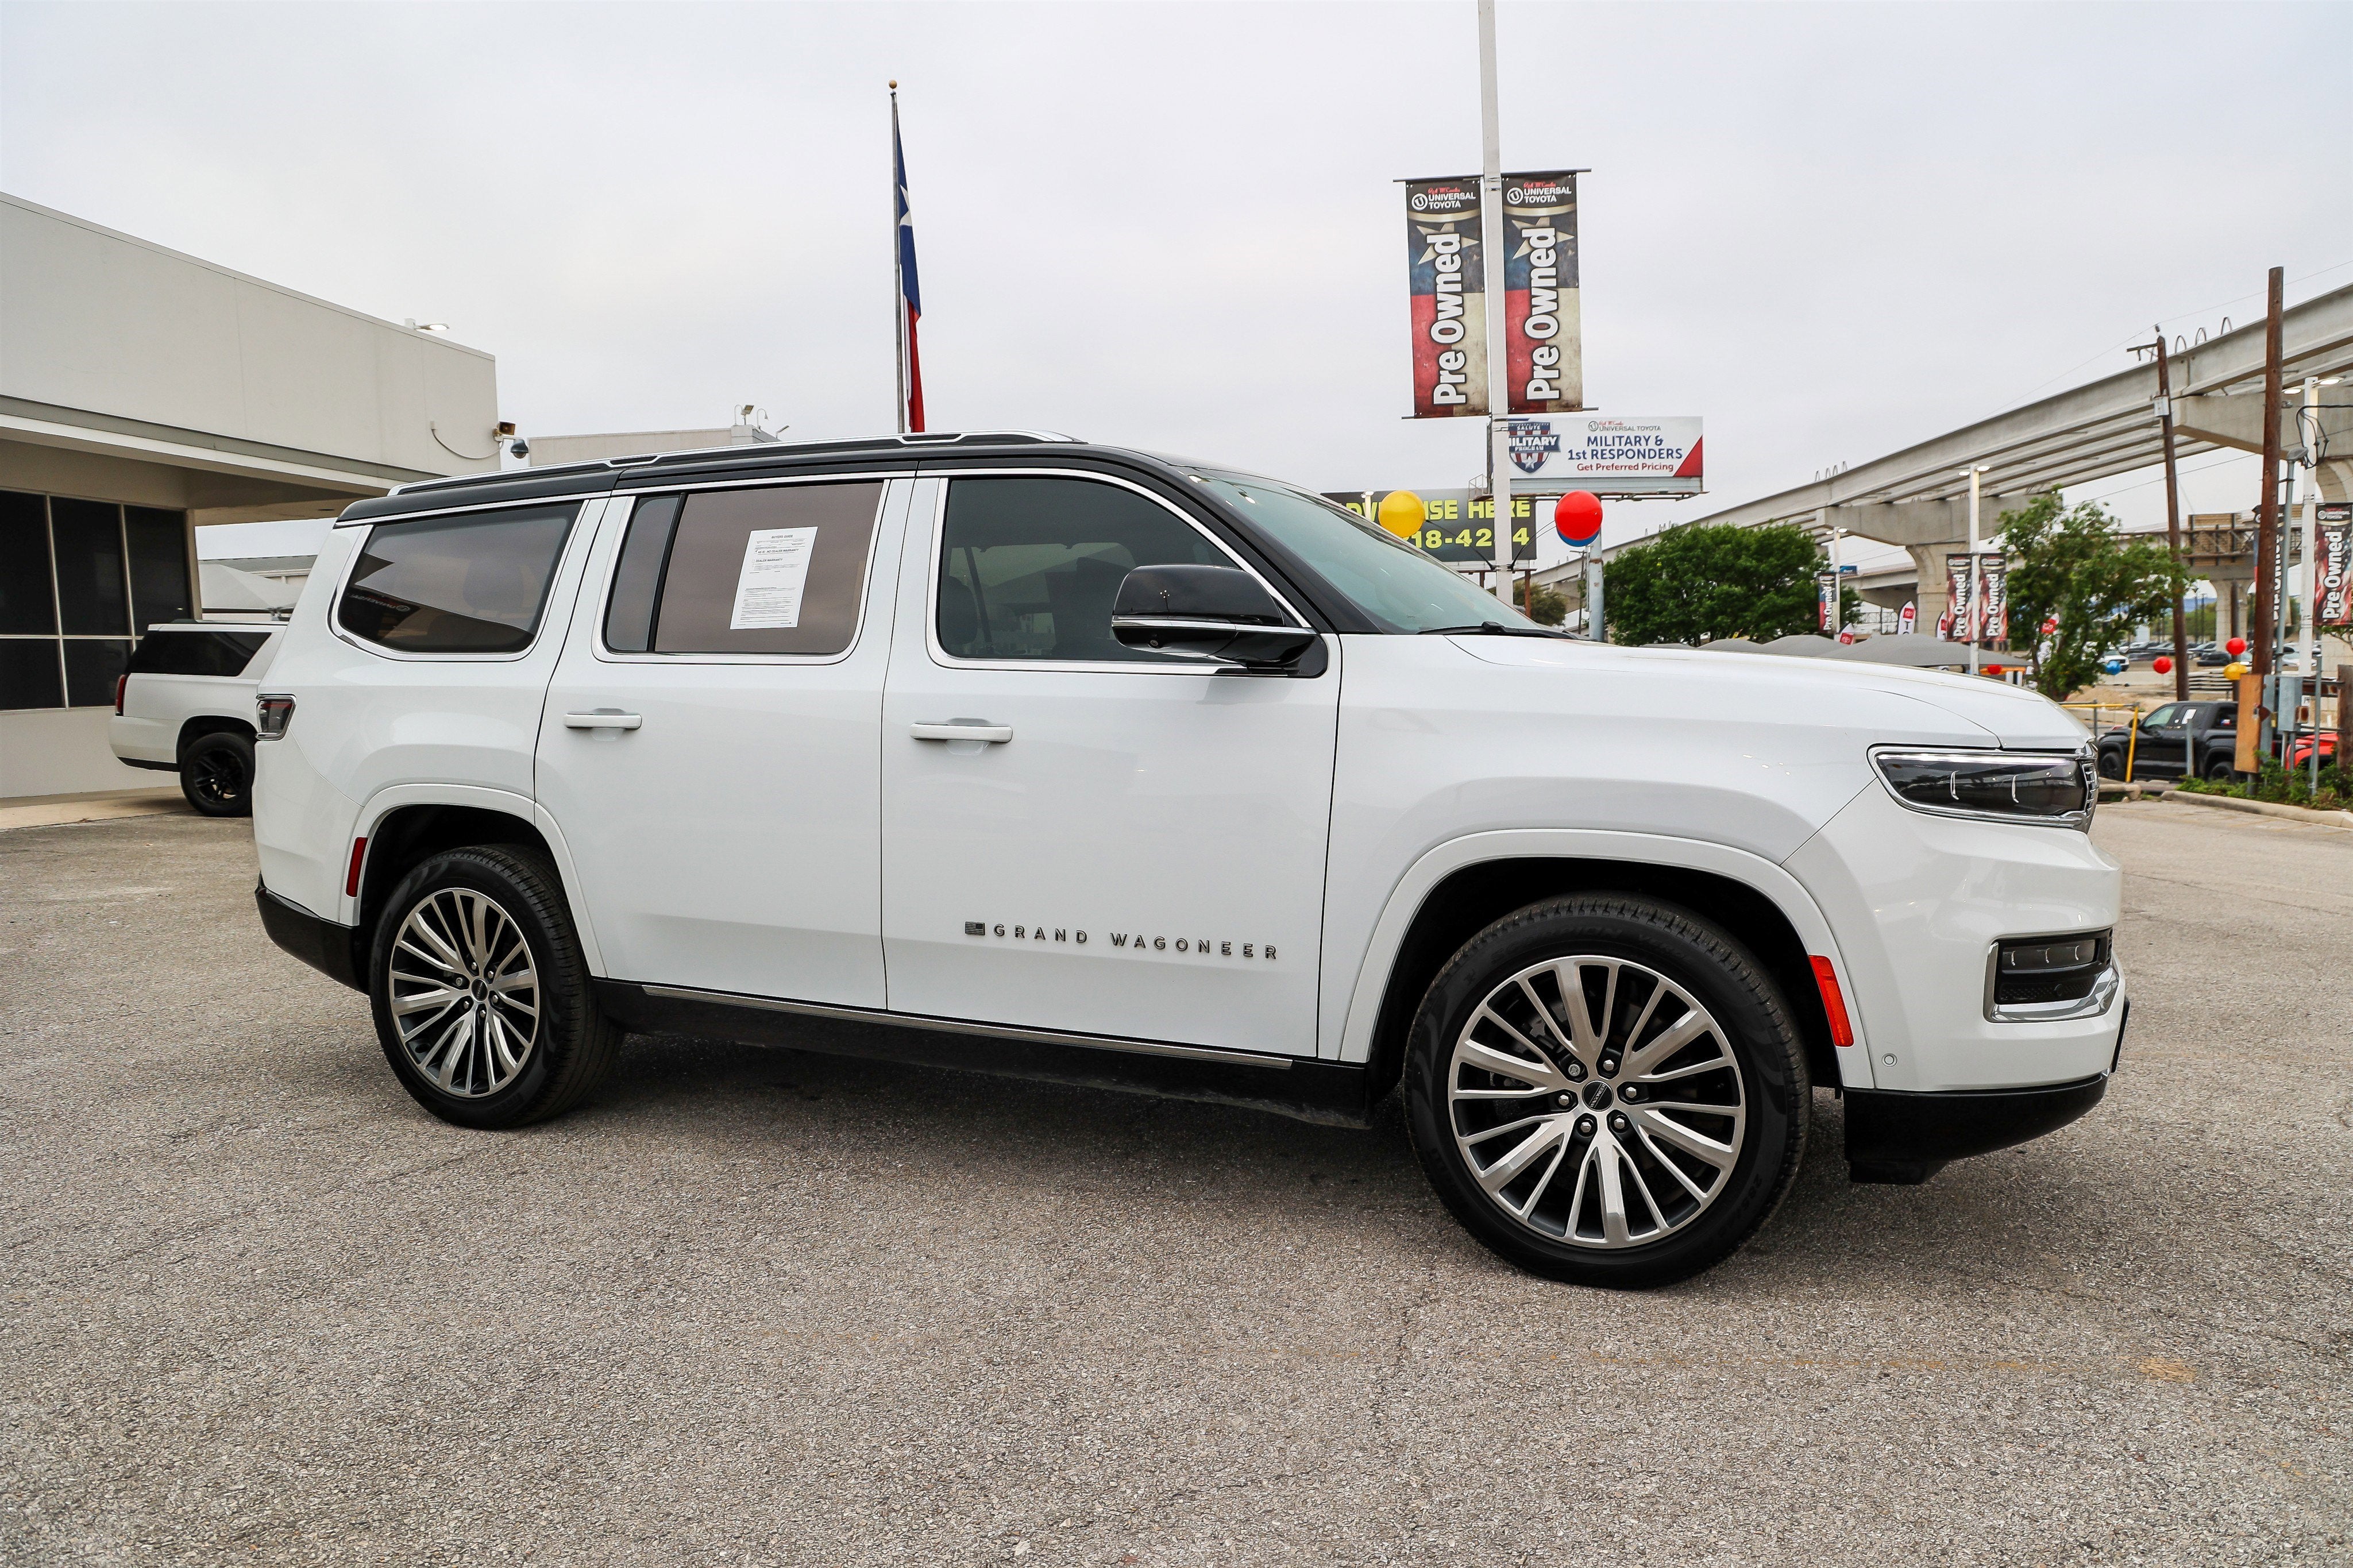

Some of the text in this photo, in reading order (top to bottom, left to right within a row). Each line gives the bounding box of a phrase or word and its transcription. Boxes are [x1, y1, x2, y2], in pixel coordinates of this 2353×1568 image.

[1428, 192, 1476, 202] UNIVERSAL
[1523, 187, 1572, 196] UNIVERSAL
[1429, 200, 1461, 210] TOYOTA
[1524, 195, 1557, 203] TOYOTA
[1521, 227, 1559, 339] Owned
[1426, 233, 1466, 405] Pre Owned
[1526, 346, 1560, 400] Pre
[1587, 435, 1664, 446] MILITARY &
[1568, 448, 1683, 460] 1st RESPONDERS
[1577, 462, 1674, 472] Get Preferred Pricing
[2324, 531, 2343, 588] Owned
[2322, 591, 2340, 619] Pre
[993, 923, 1277, 960] GRAND WAGONEER
